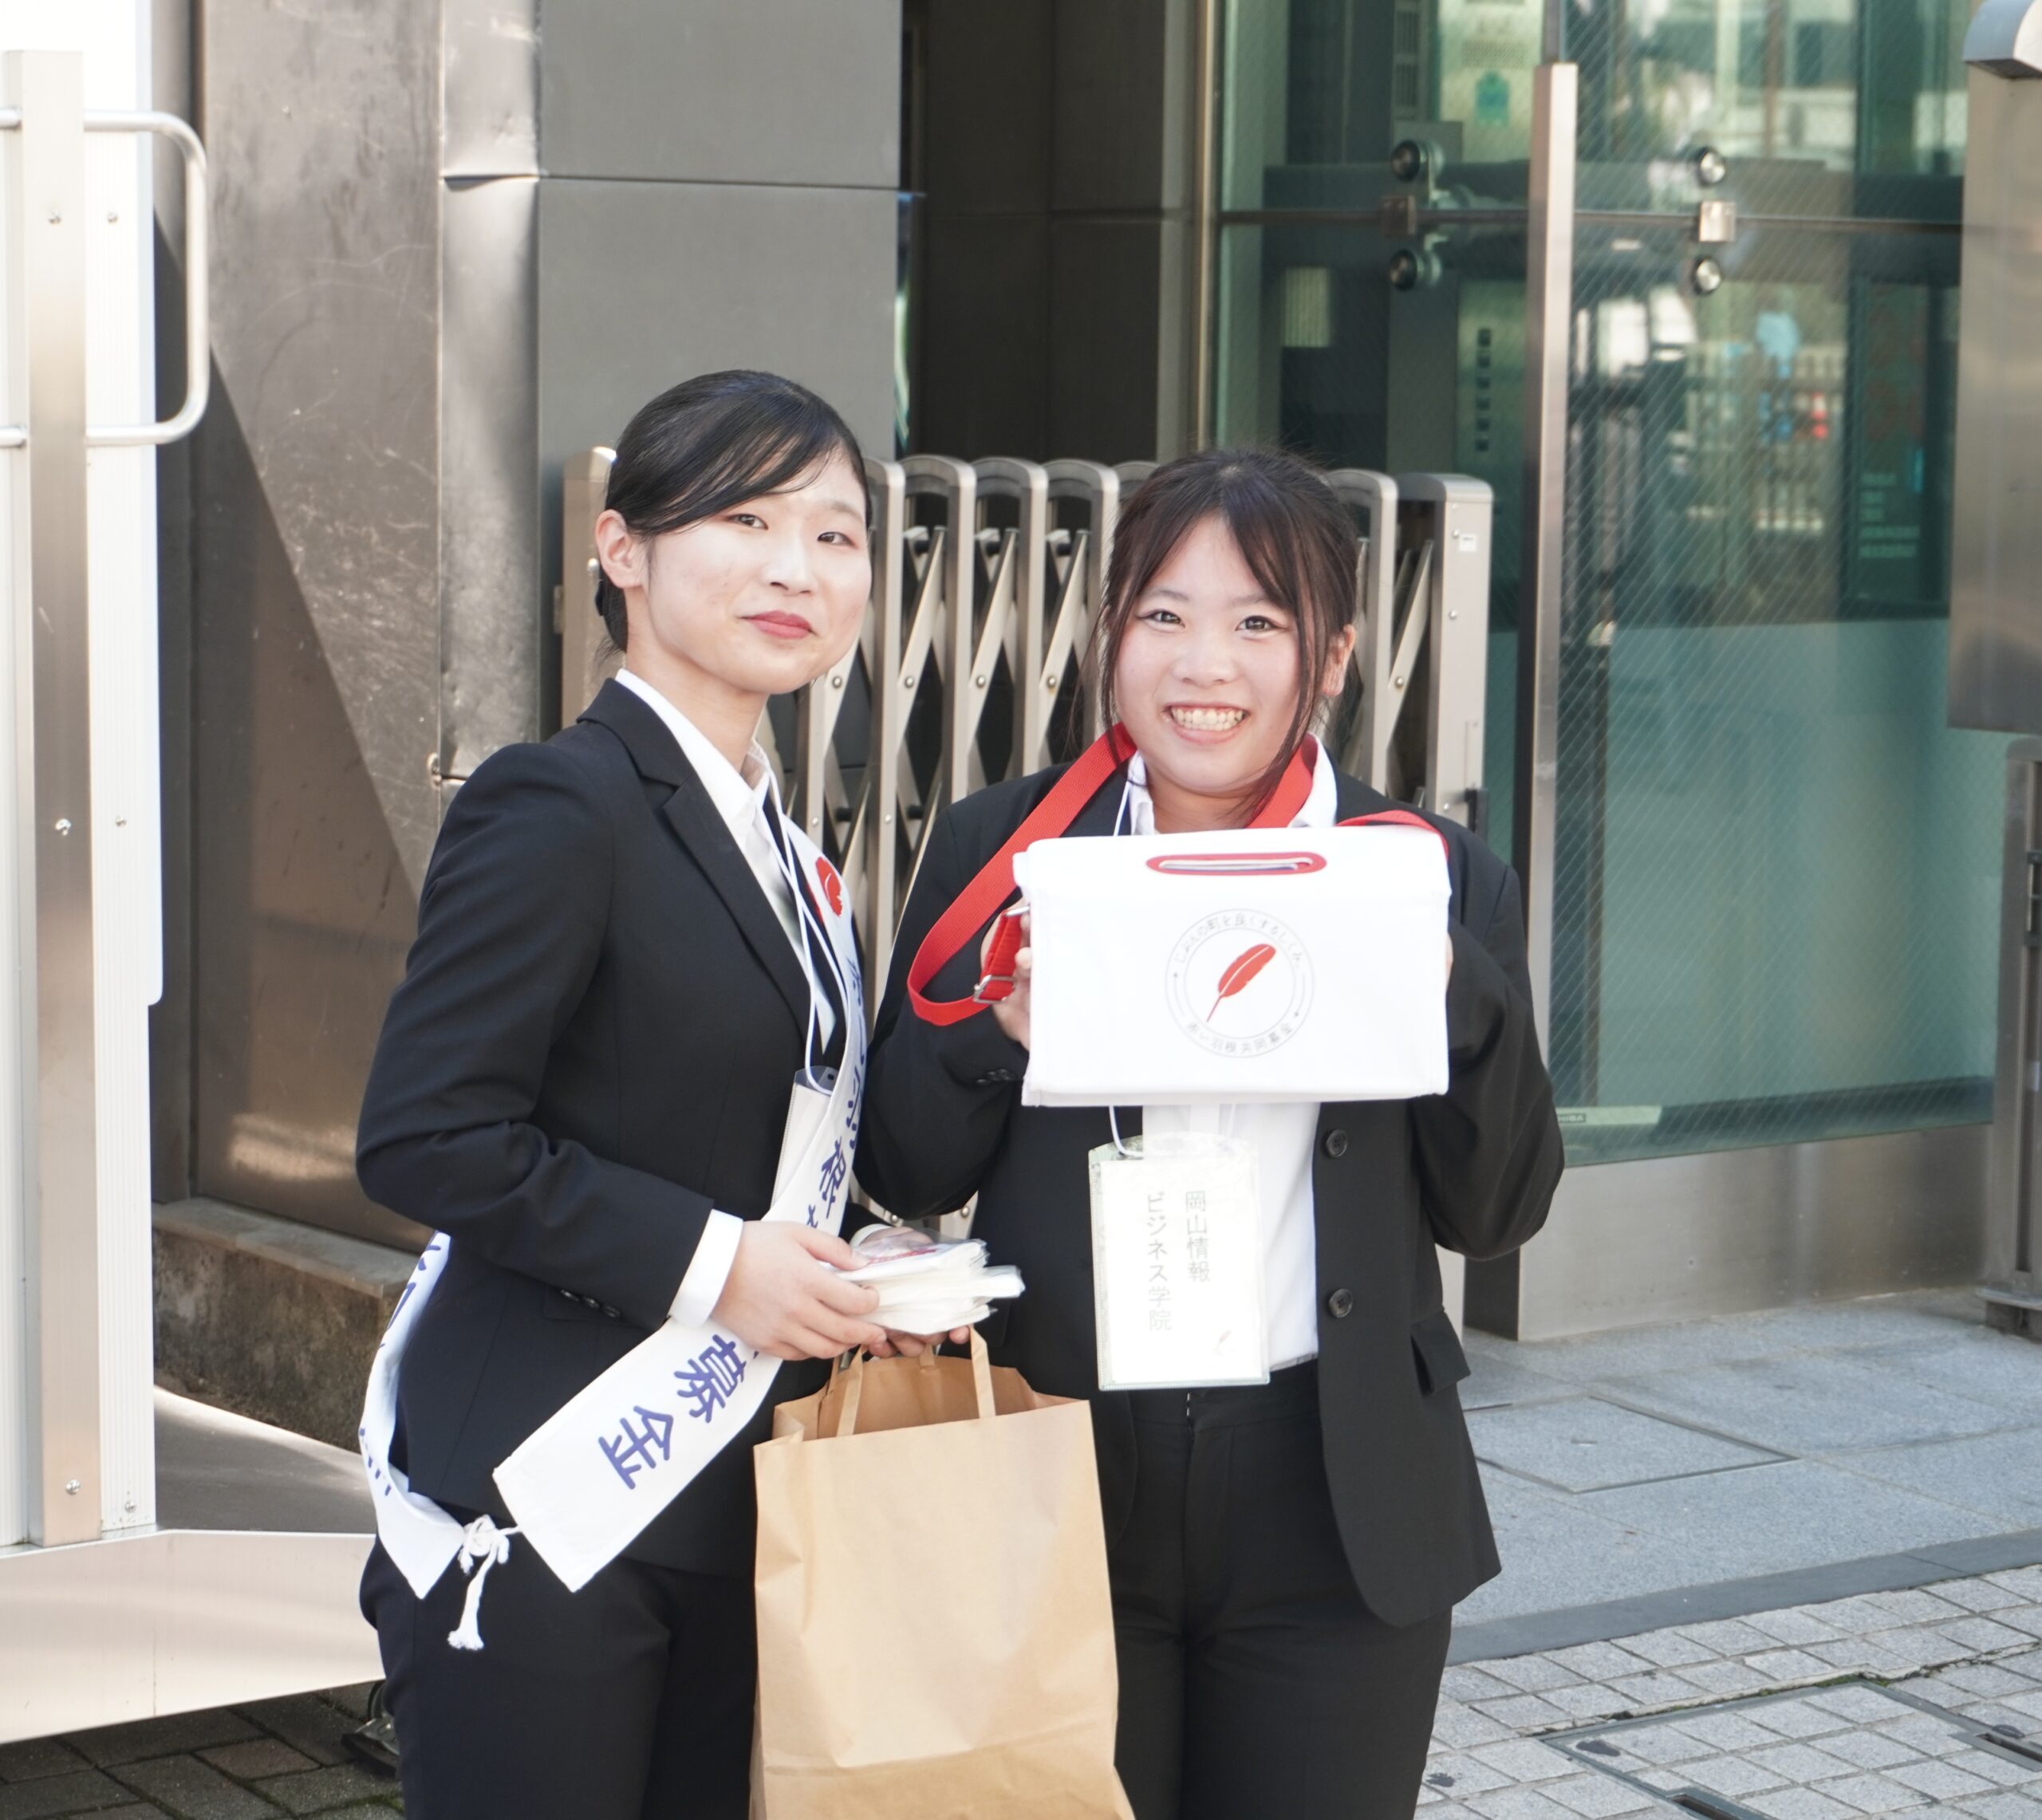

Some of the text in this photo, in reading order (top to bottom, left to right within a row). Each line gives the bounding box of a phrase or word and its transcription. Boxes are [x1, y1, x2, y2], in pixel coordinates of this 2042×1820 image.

[1145, 1191, 1171, 1331] ビジネス学院
[1185, 1190, 1211, 1282] 岡山情報
